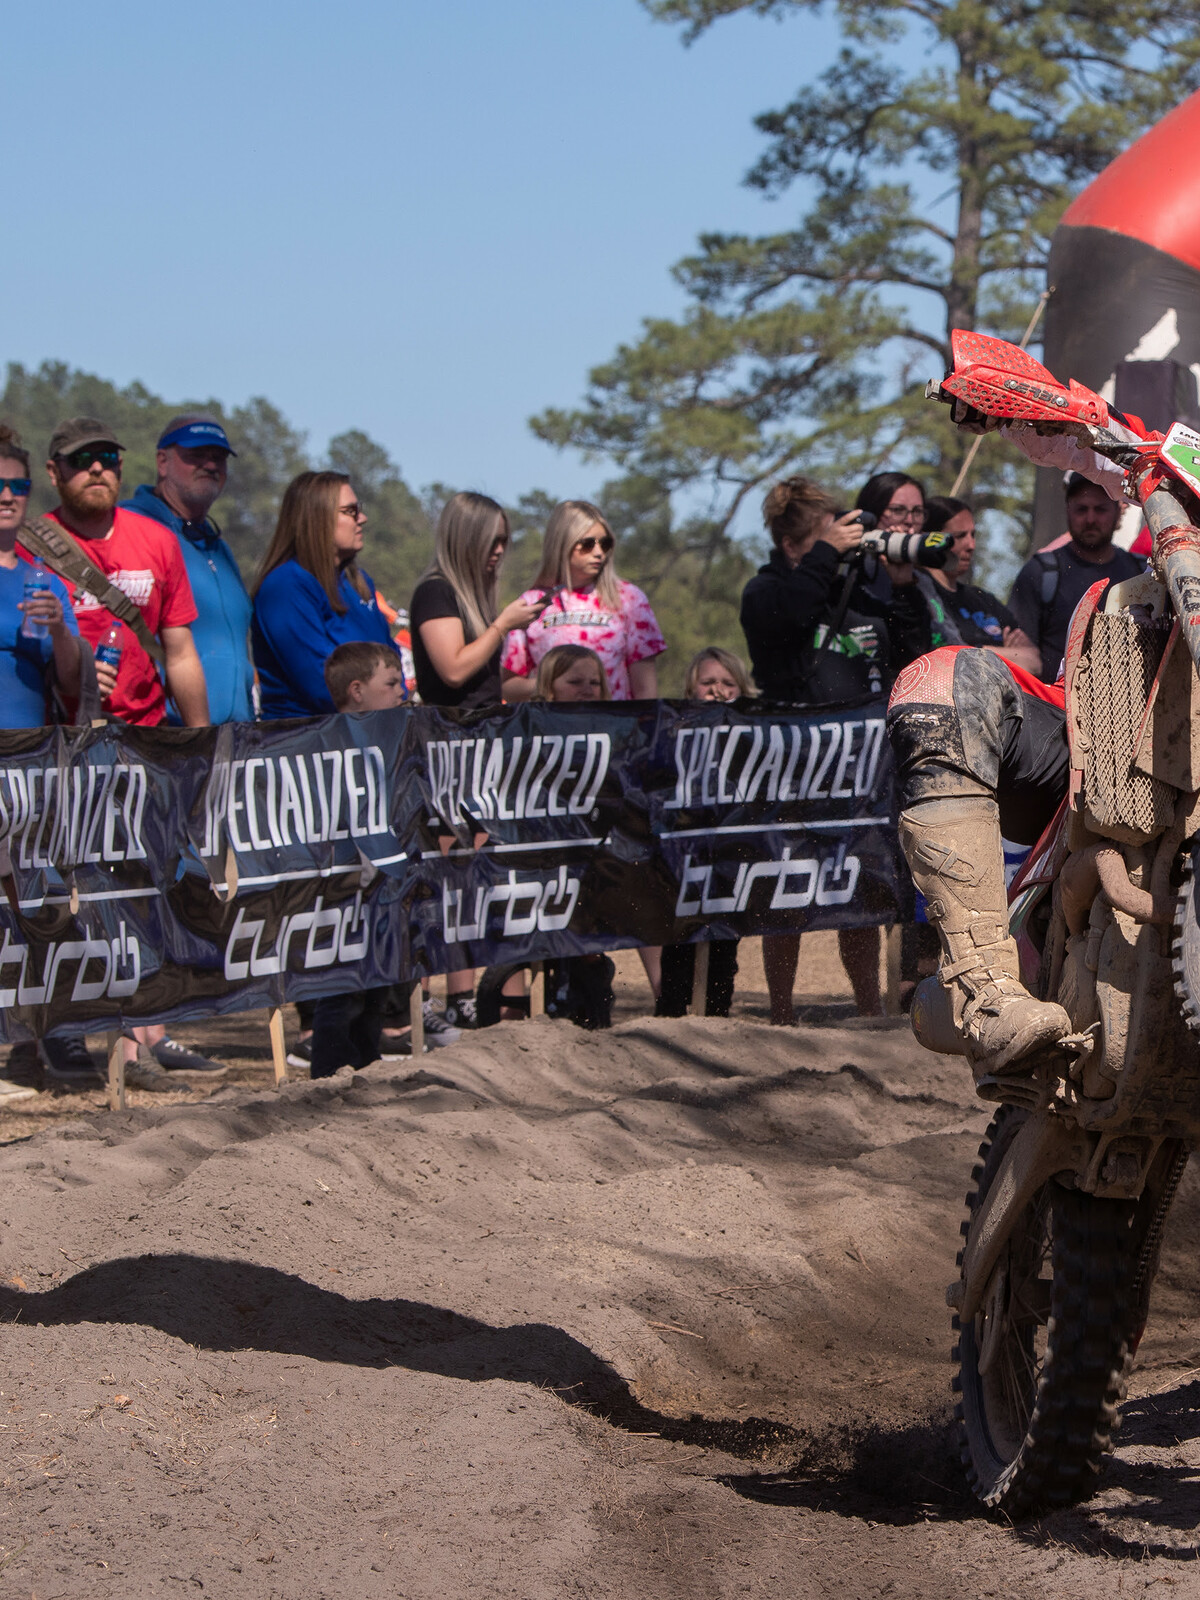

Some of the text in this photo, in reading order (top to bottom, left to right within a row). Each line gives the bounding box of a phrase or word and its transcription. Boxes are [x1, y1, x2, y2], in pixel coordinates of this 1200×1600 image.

[427, 733, 611, 826] SPECIALIZED
[662, 719, 886, 810] SPECIALIZED
[443, 865, 581, 944] turbo
[675, 843, 861, 918] turbo
[225, 890, 369, 981] turbo
